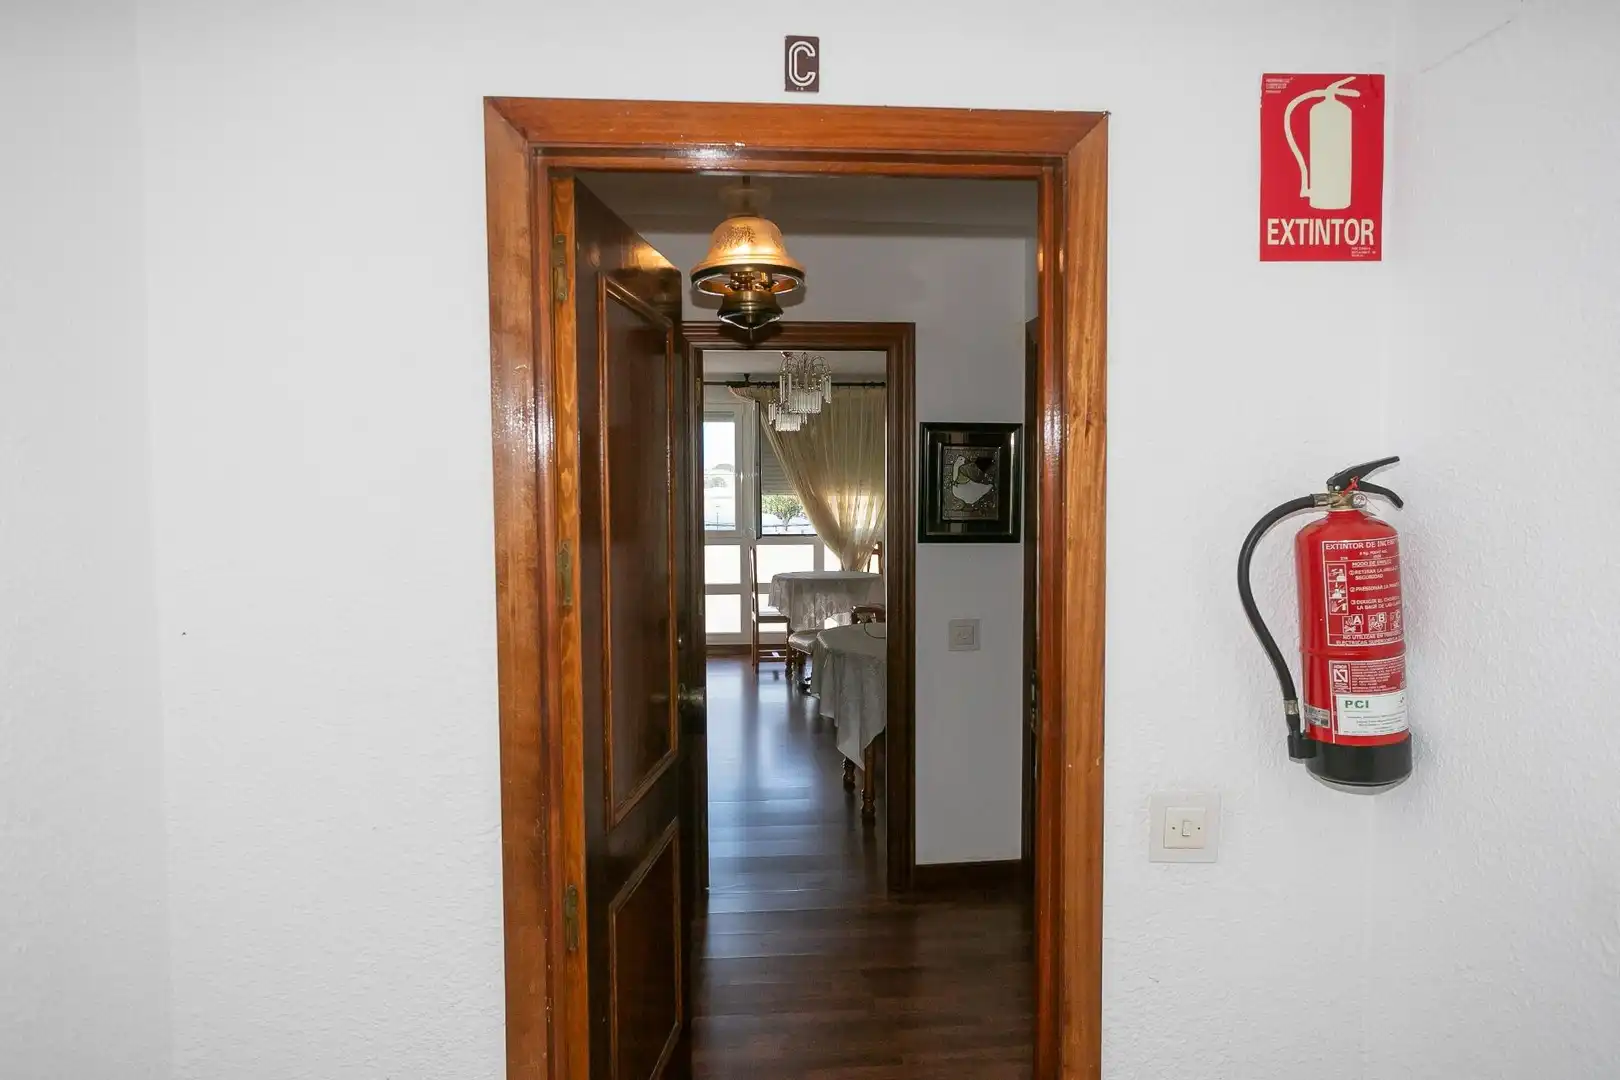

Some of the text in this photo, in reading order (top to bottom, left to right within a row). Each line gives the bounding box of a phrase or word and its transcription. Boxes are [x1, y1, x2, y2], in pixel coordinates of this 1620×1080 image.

[788, 40, 816, 87] C
[1266, 218, 1374, 246] EXTINTOR
[1325, 542, 1364, 550] EXTINTOR
[1353, 615, 1362, 625] A
[1378, 613, 1385, 622] B
[1344, 700, 1369, 709] PCI
